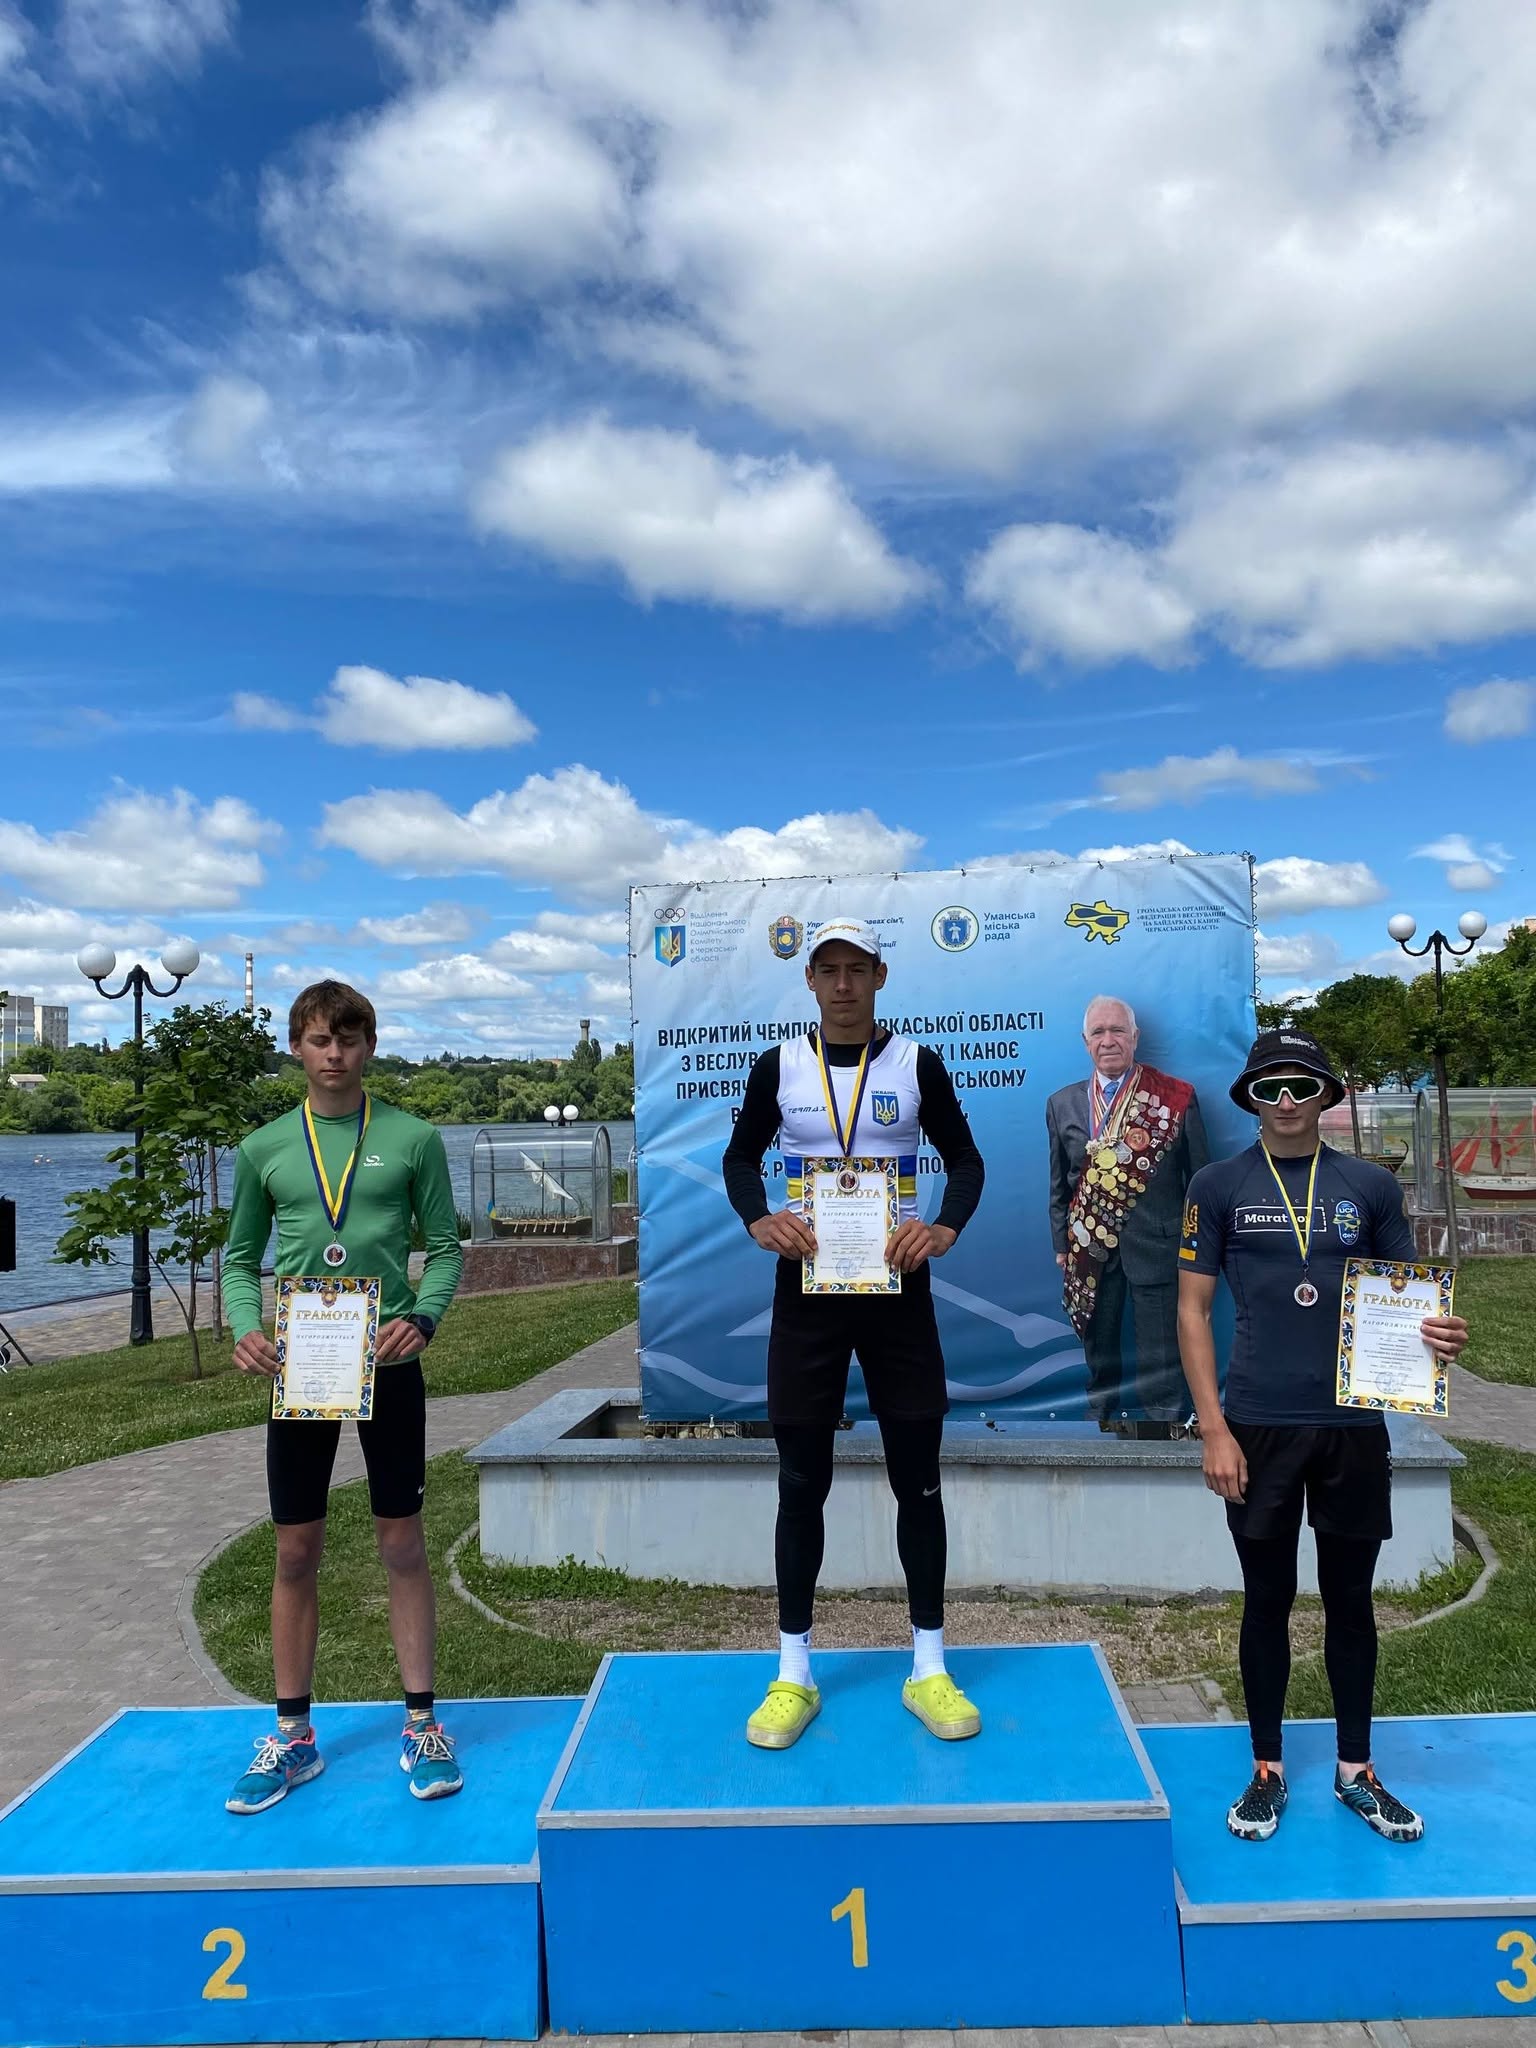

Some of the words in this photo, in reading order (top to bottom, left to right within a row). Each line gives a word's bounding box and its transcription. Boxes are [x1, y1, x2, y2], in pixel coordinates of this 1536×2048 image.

[984, 911, 1036, 921] Уманська
[984, 922, 1020, 931] міська
[1145, 925, 1186, 933] ЧЕРКАСЬКОЇ
[985, 932, 1011, 942] рада
[658, 1021, 751, 1049] ВІДКРИТИЙ
[757, 1022, 819, 1041] ЧЕМПІО
[873, 1011, 964, 1035] РКАСЬКОЇ
[969, 1012, 1044, 1032] ОБЛАСТІ
[682, 1056, 691, 1072] З
[696, 1051, 759, 1071] ВЕСЛУВ
[950, 1044, 955, 1061] І
[960, 1041, 1020, 1061] КАНОЄ
[788, 1106, 827, 1114] TERMAX
[1244, 1213, 1308, 1223] Marato
[1362, 1293, 1433, 1311] ГРАМОТА
[295, 1310, 361, 1321] ГРАМОТА
[831, 1887, 869, 1968] 1
[202, 1927, 247, 2001] 2
[1496, 1930, 1536, 2004] 3
